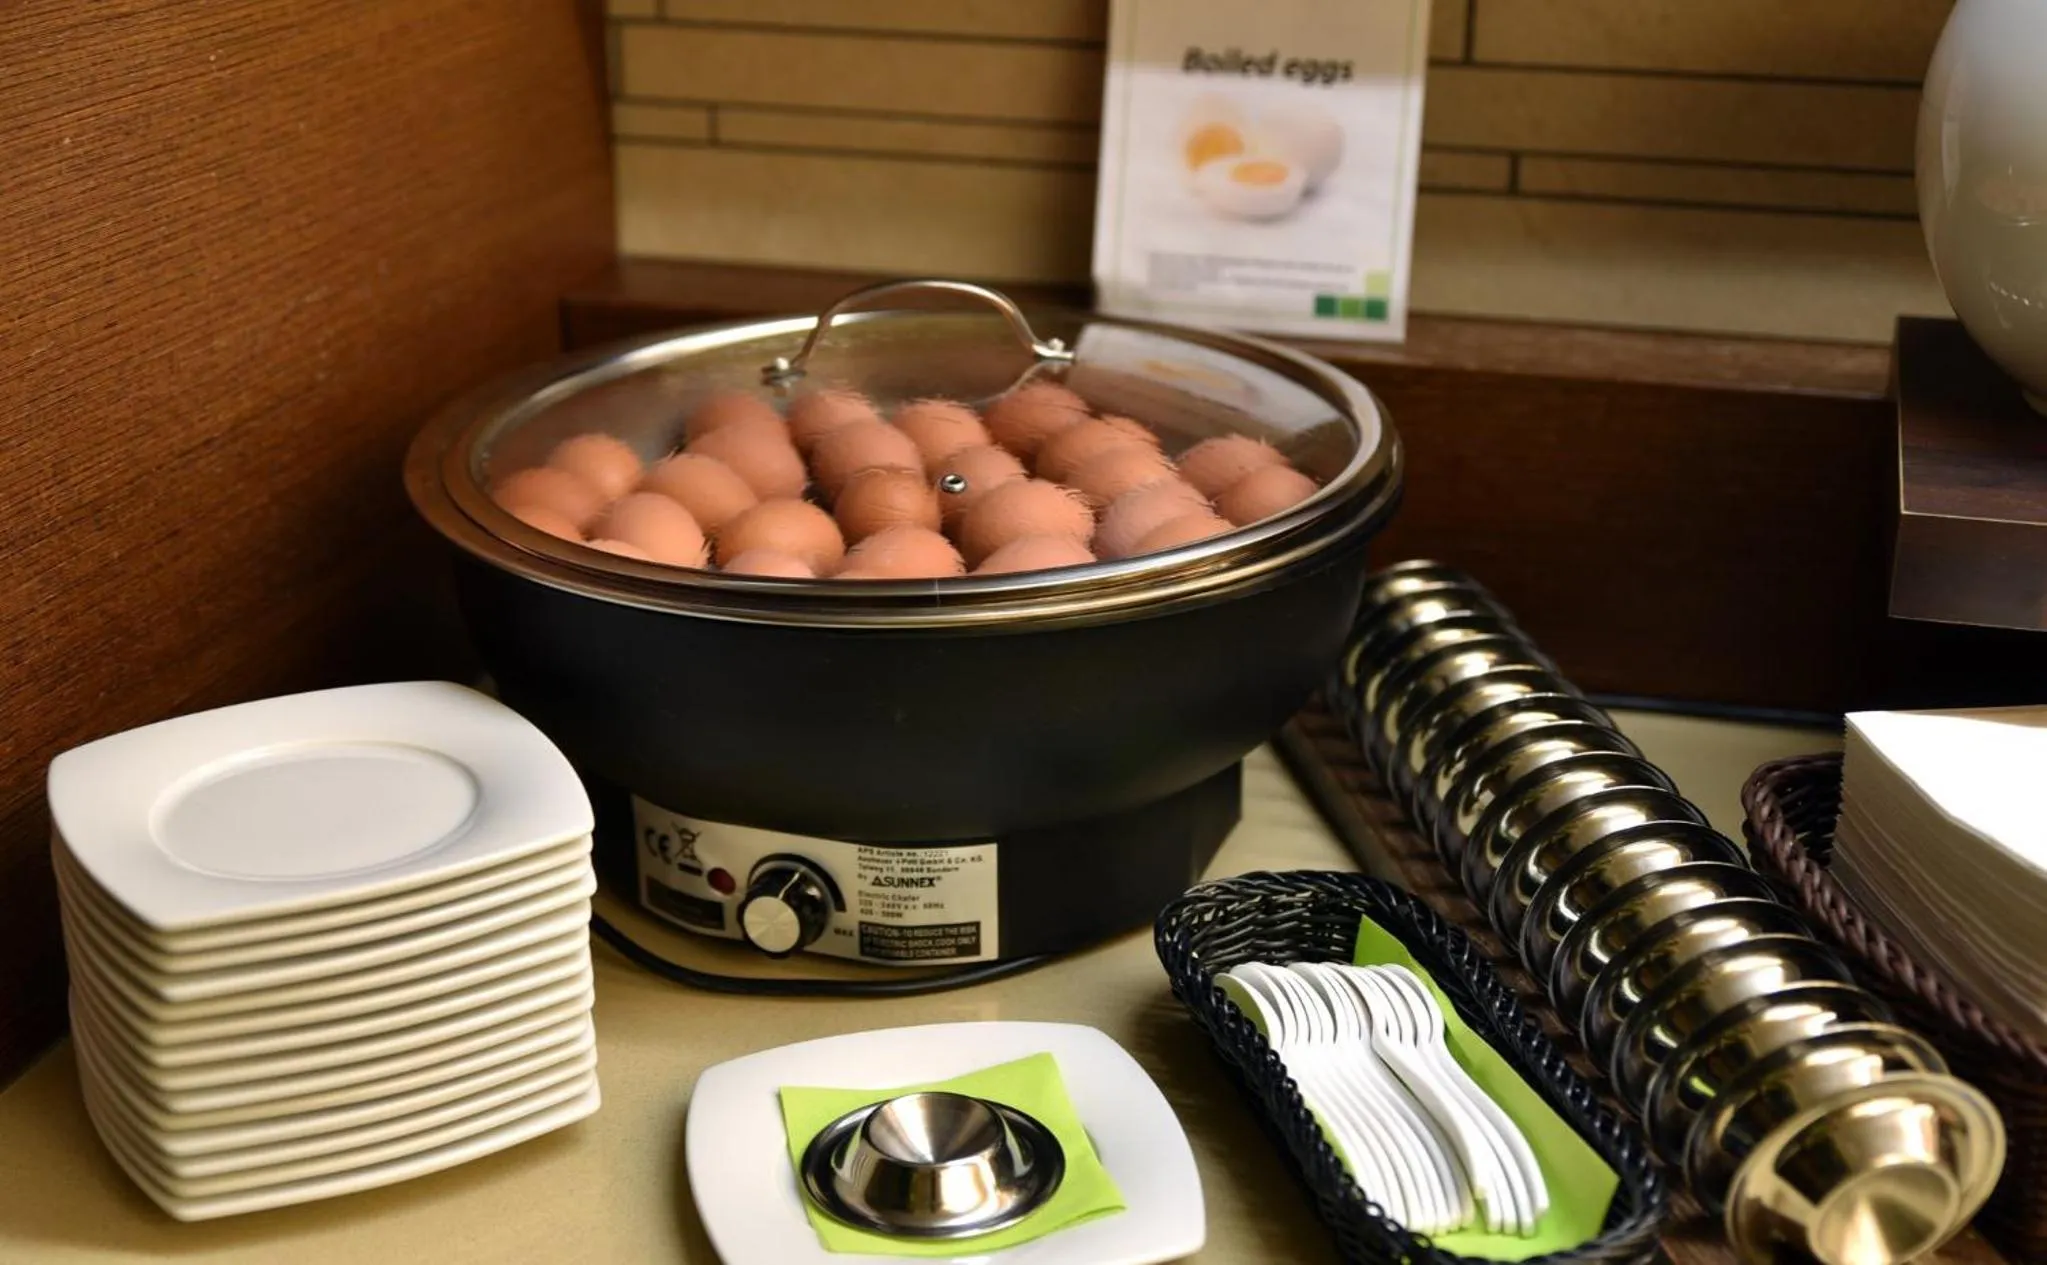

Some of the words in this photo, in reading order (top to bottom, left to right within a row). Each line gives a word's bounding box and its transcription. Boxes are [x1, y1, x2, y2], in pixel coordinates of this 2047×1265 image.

[1181, 46, 1277, 77] Boiled
[1283, 58, 1353, 84] eggs
[858, 890, 889, 901] Electric
